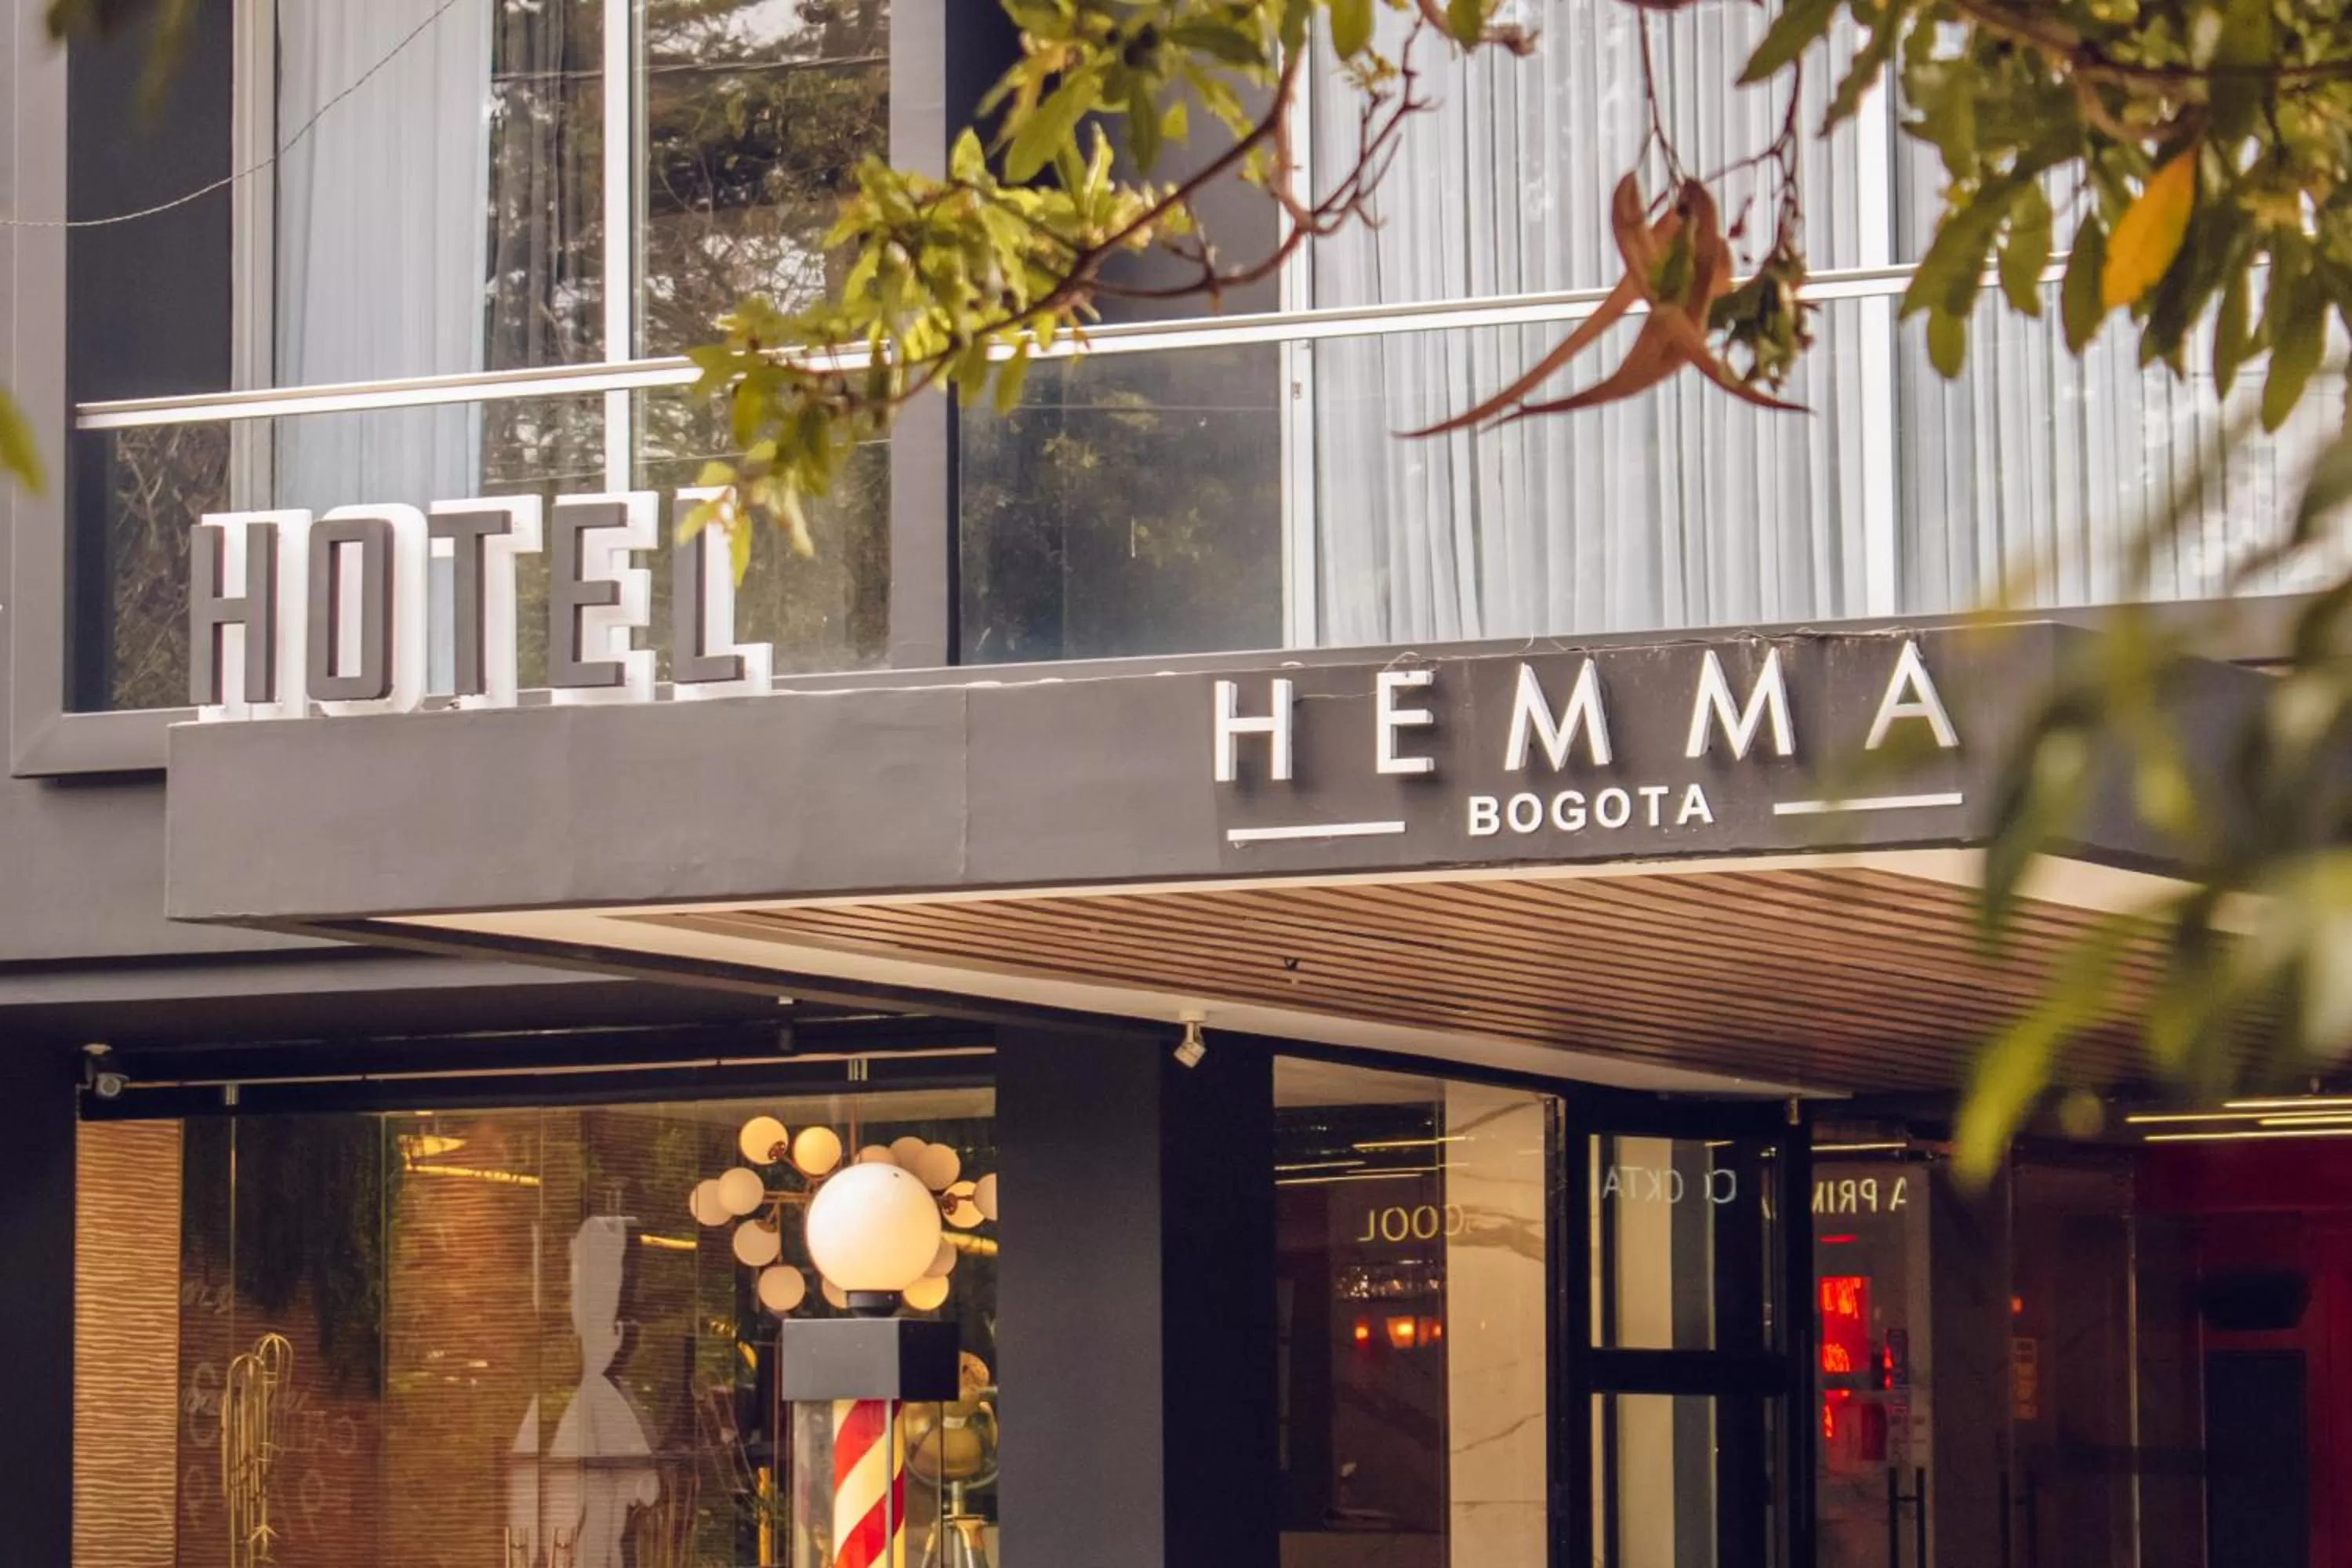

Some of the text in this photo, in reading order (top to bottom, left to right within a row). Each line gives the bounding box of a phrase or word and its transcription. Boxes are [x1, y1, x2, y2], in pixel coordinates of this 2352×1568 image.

[190, 486, 772, 723] HOTEL
[1214, 640, 1960, 781] HEMMA
[1468, 784, 1714, 837] BOGOTA
